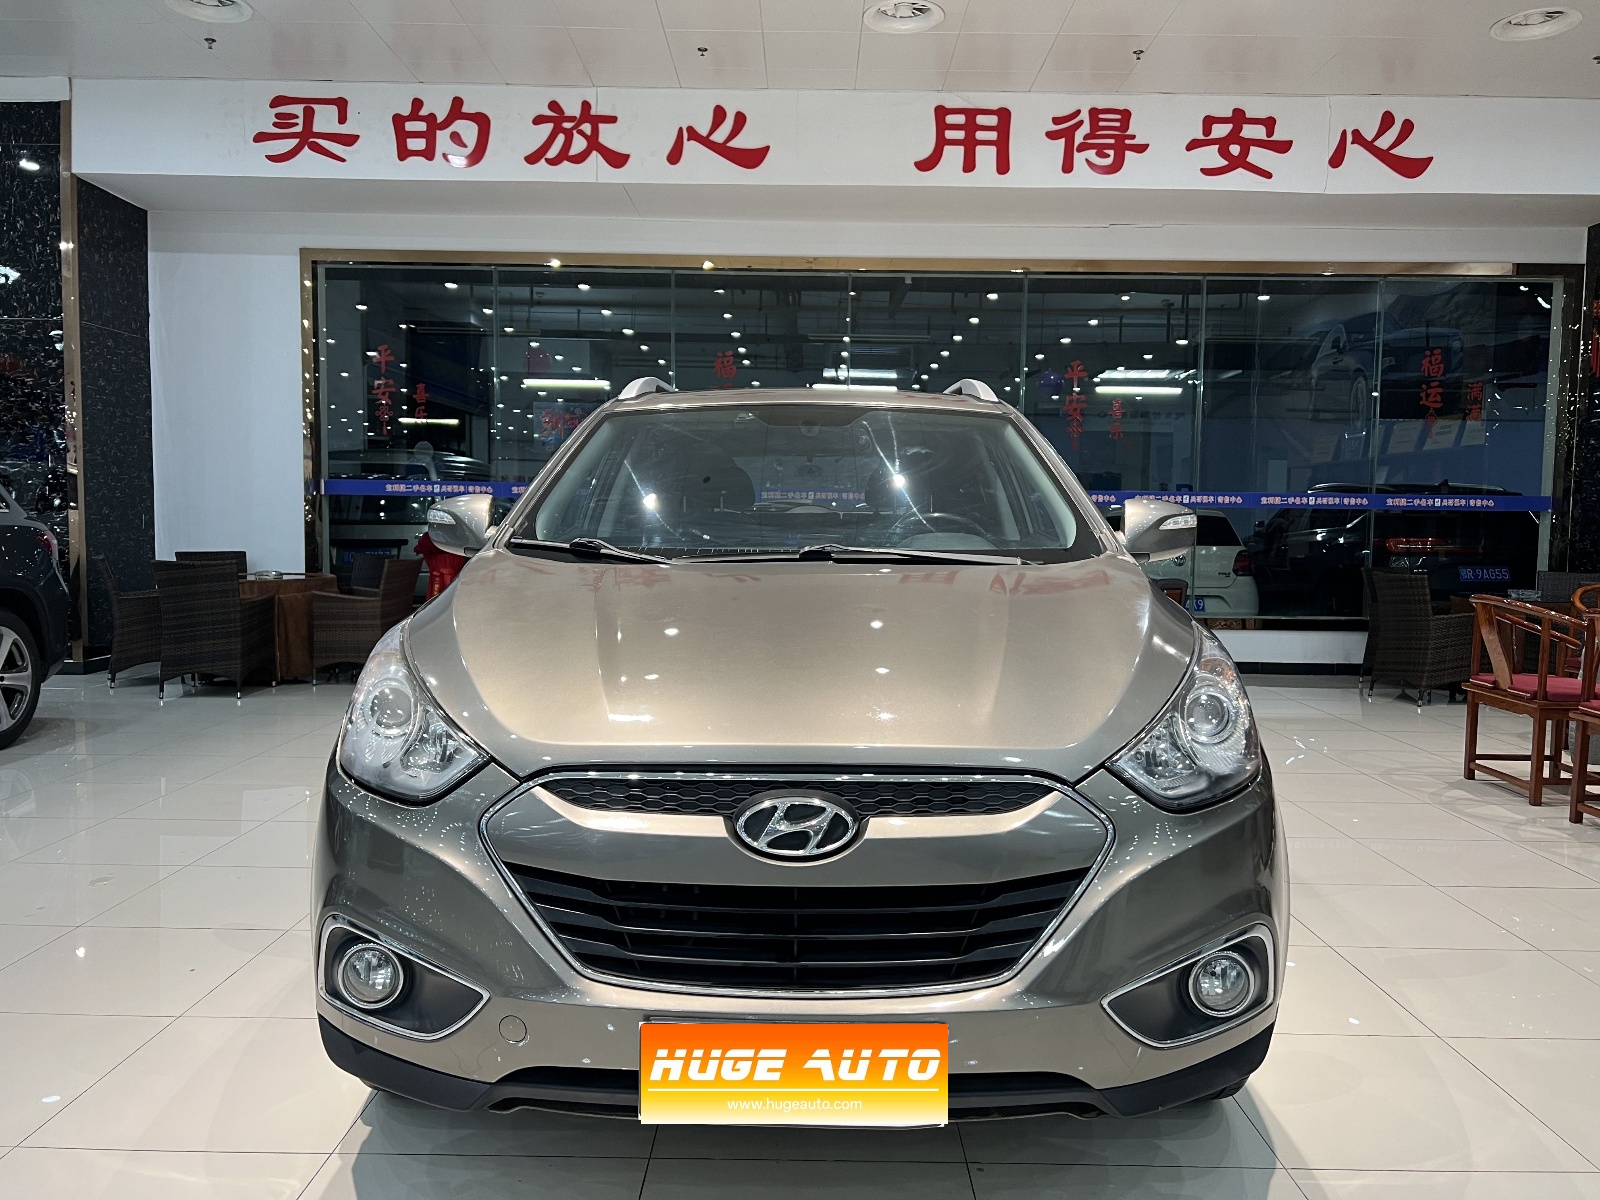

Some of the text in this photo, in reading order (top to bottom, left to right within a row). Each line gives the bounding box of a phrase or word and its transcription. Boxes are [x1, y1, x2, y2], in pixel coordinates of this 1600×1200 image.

[253, 94, 1434, 180] 买的放心 用得安心
[372, 344, 396, 405] 平安
[714, 351, 736, 388] 福
[1064, 360, 1088, 422] 平安
[1420, 348, 1444, 408] 福运
